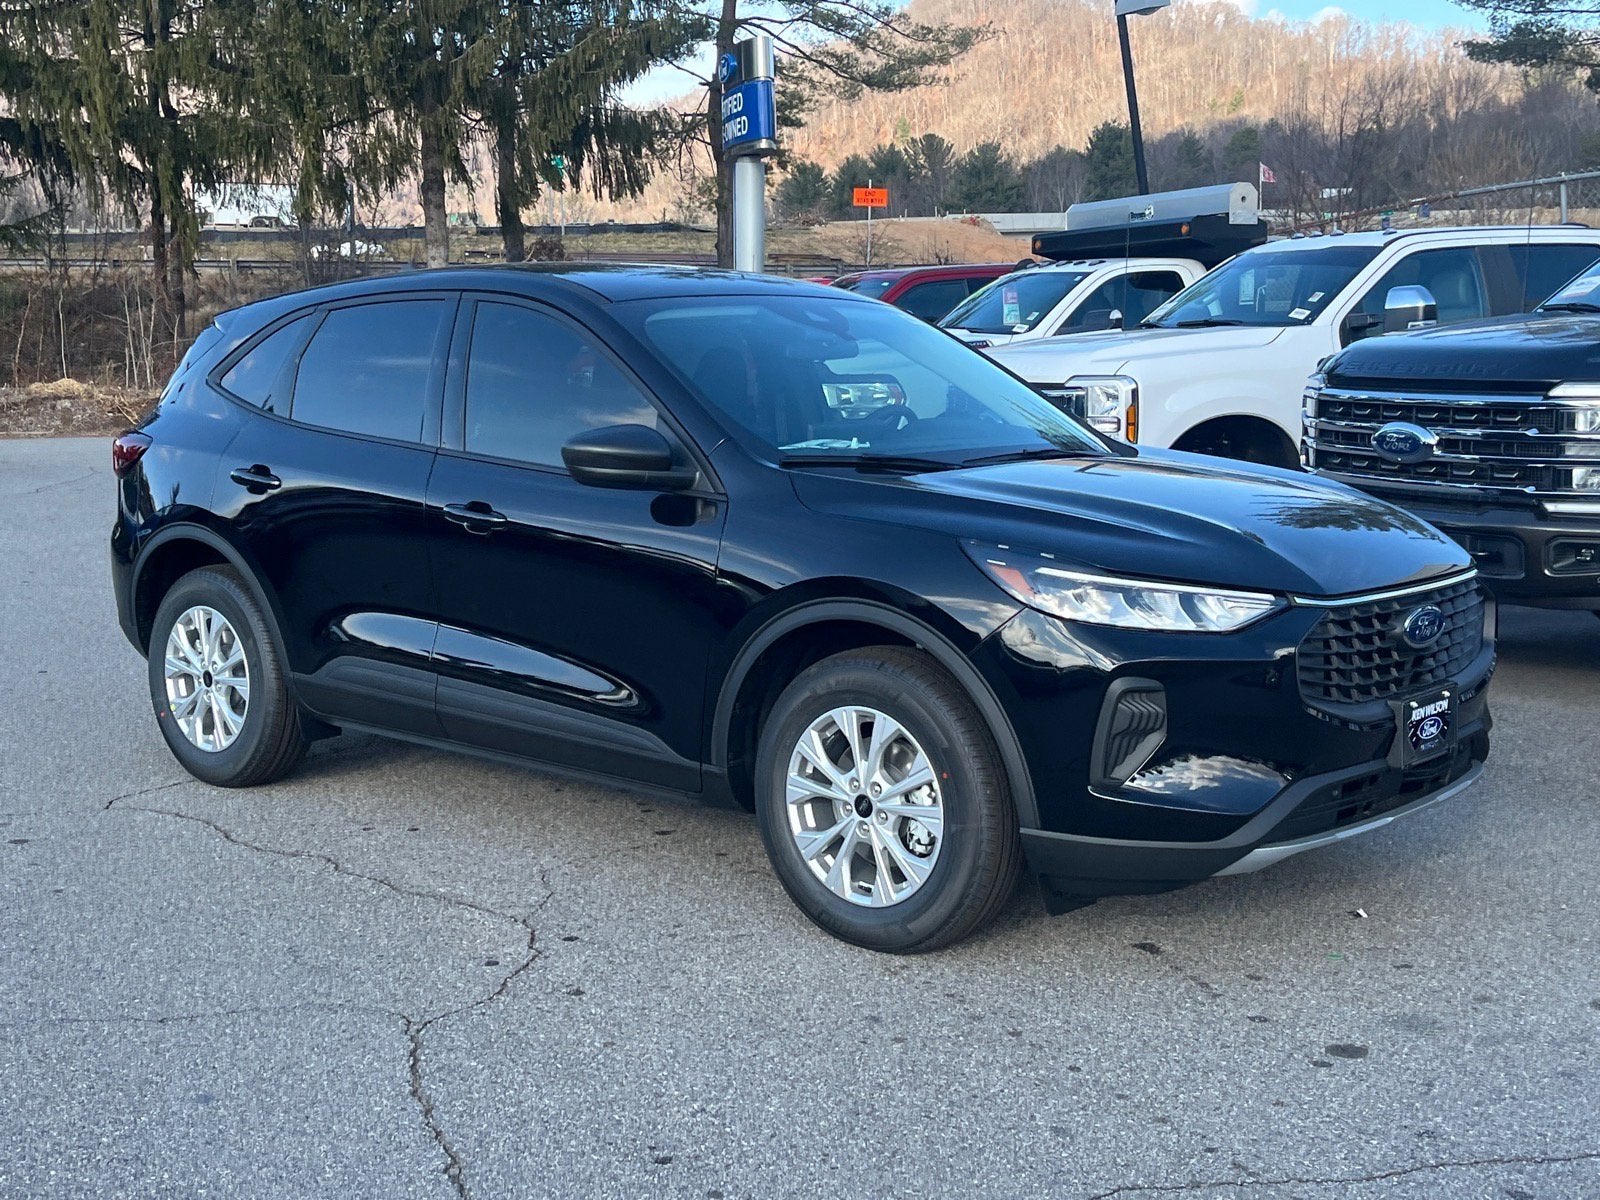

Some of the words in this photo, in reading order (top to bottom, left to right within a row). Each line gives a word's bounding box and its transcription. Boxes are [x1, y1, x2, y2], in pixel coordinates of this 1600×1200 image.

[1382, 433, 1412, 451] Ford
[1412, 706, 1426, 721] KEN
[1425, 699, 1449, 717] WILSON
[1422, 720, 1438, 737] Ford
